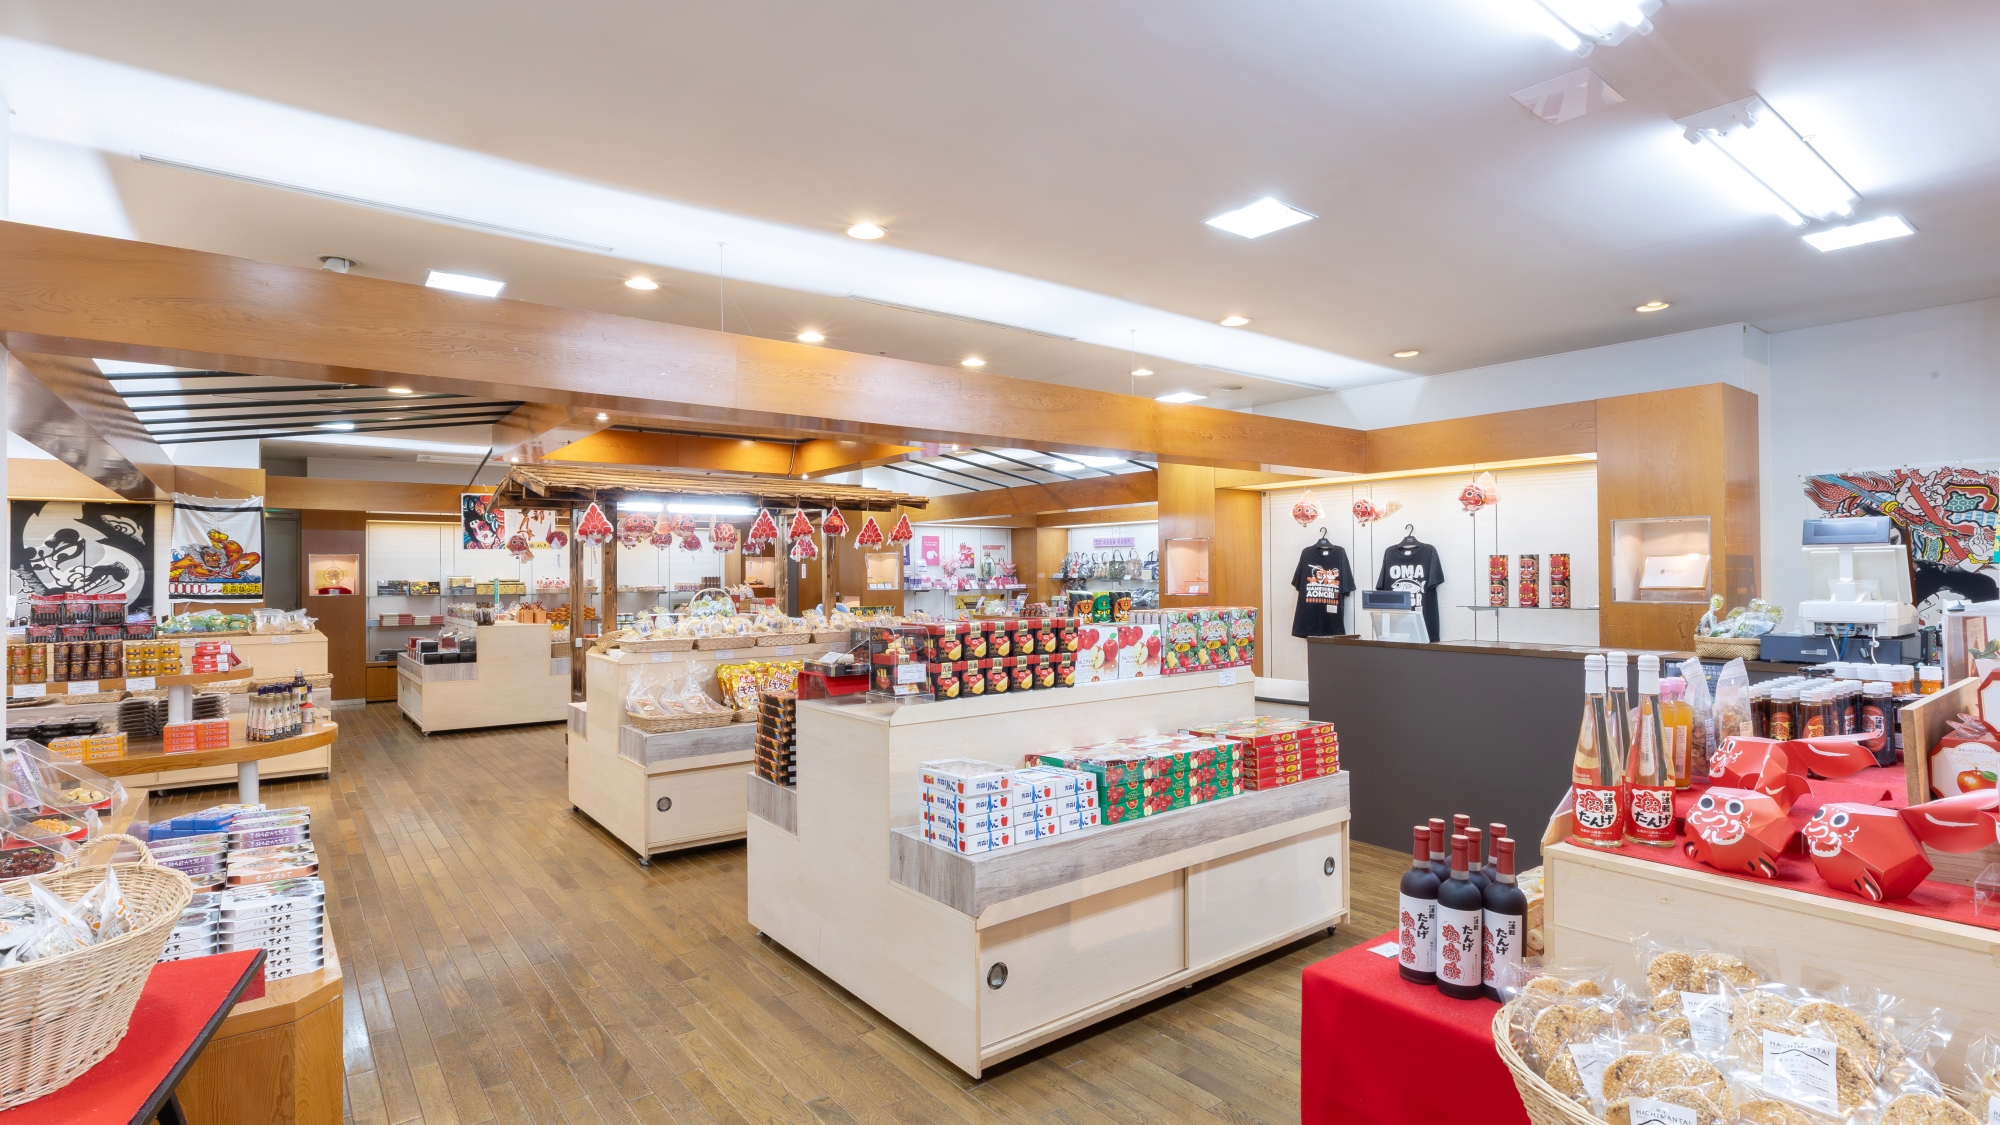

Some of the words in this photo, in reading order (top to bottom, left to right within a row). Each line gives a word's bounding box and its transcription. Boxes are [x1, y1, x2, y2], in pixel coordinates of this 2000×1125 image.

[1389, 564, 1424, 579] OMA
[222, 584, 260, 594] 青森ねぶた
[1306, 591, 1335, 599] AOMORI
[1603, 797, 1614, 812] 津軽
[1662, 797, 1671, 812] 津軽
[1578, 811, 1615, 828] たんげ
[1634, 811, 1671, 828] たんげ
[1429, 907, 1435, 919] 津軽
[1417, 912, 1430, 940] たんげ
[1473, 920, 1479, 931] 津軽
[1508, 923, 1516, 936] 津軽
[1461, 924, 1475, 953] たんげ
[1495, 927, 1510, 956] たんげ
[1769, 1040, 1830, 1057] HACHIMANTAI
[1635, 1109, 1692, 1125] HACHIMANTAI
